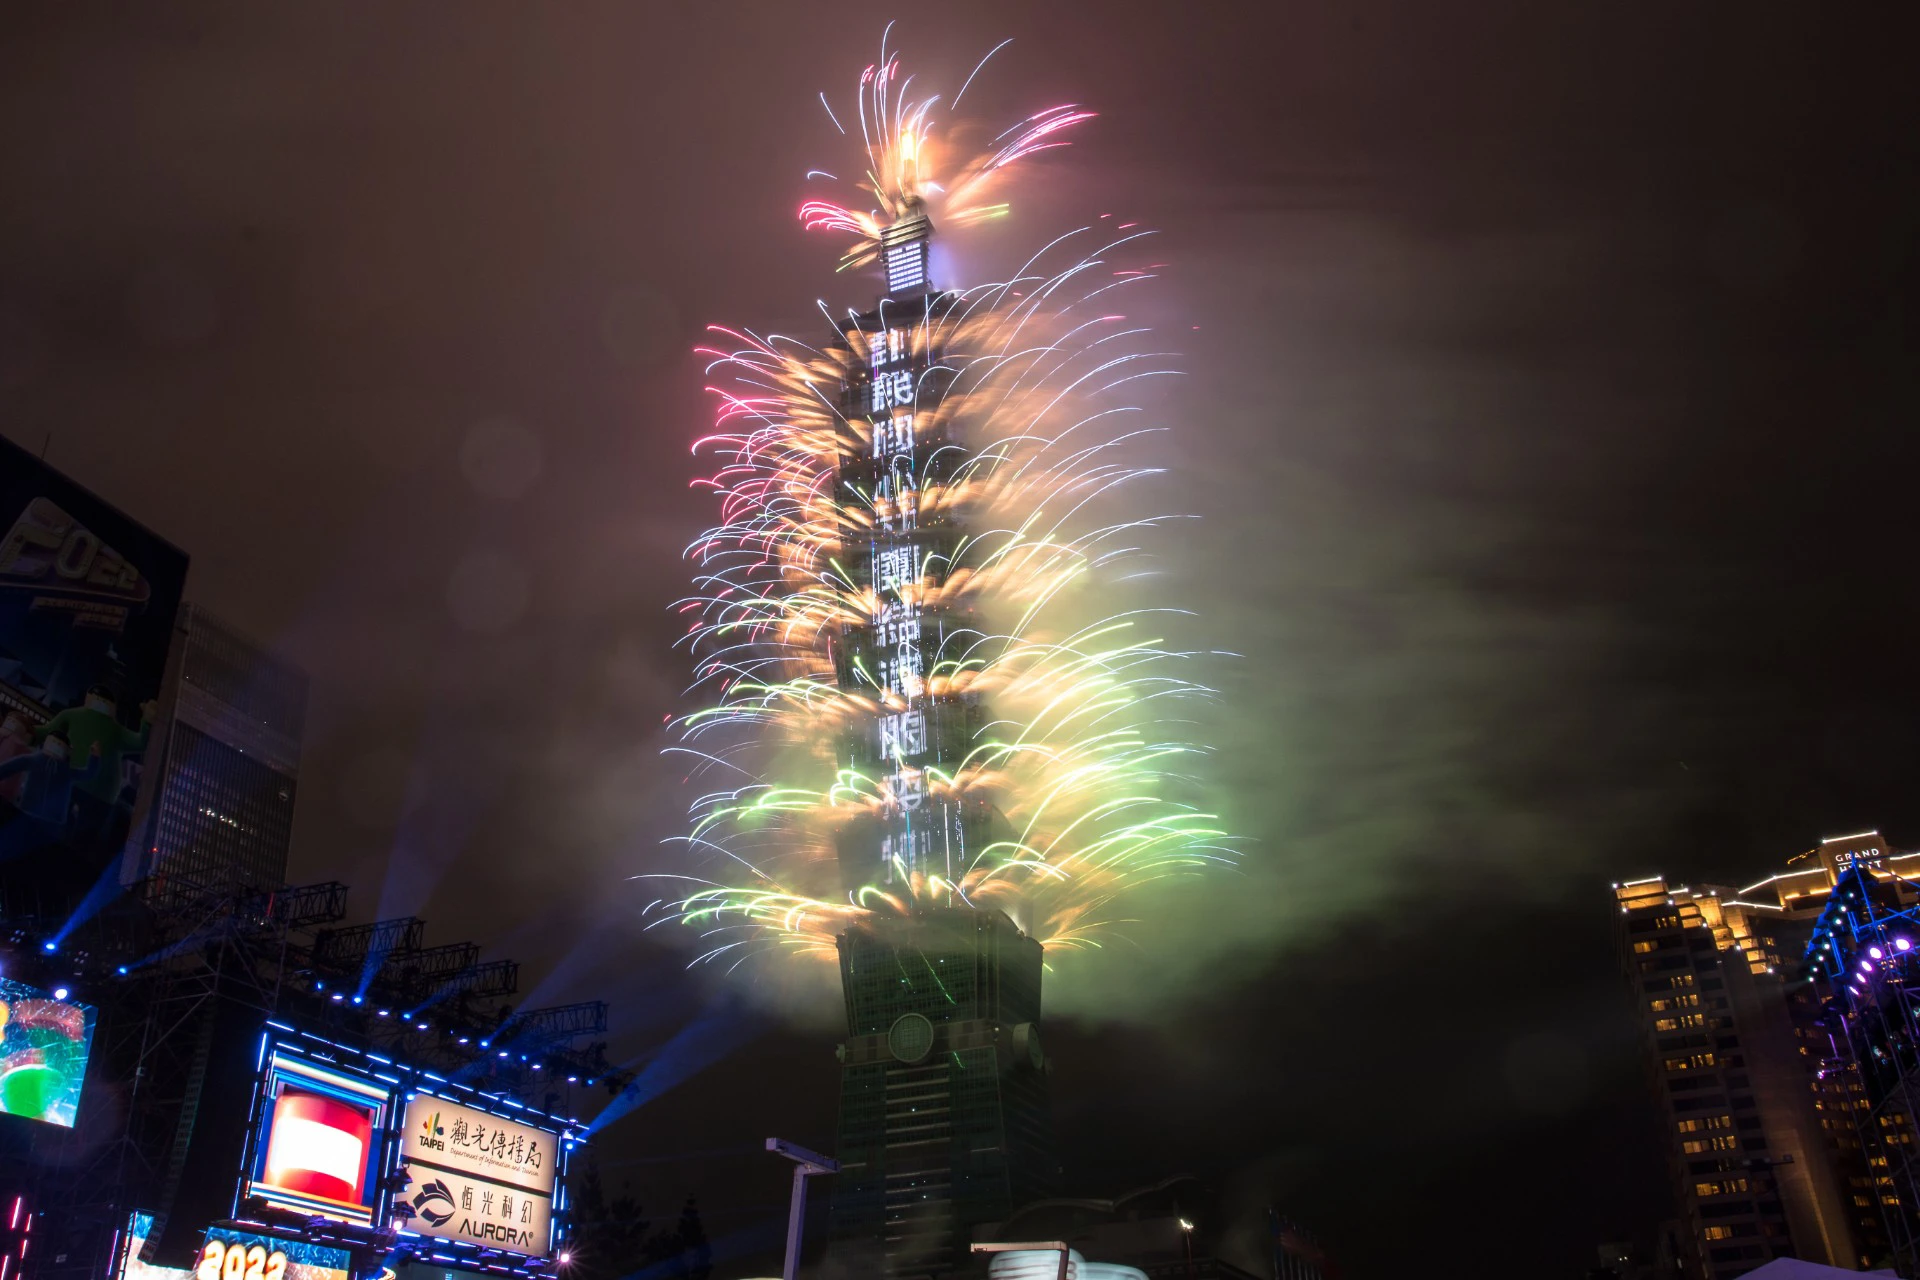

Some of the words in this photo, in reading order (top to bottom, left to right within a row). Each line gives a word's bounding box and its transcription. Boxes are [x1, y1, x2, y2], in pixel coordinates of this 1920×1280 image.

[1835, 848, 1880, 862] GRAND
[419, 1135, 445, 1152] TAIPEI
[450, 1116, 542, 1169] 觀光傳播局
[450, 1147, 478, 1160] Department
[484, 1156, 511, 1169] Information
[196, 1240, 287, 1280] 2022
